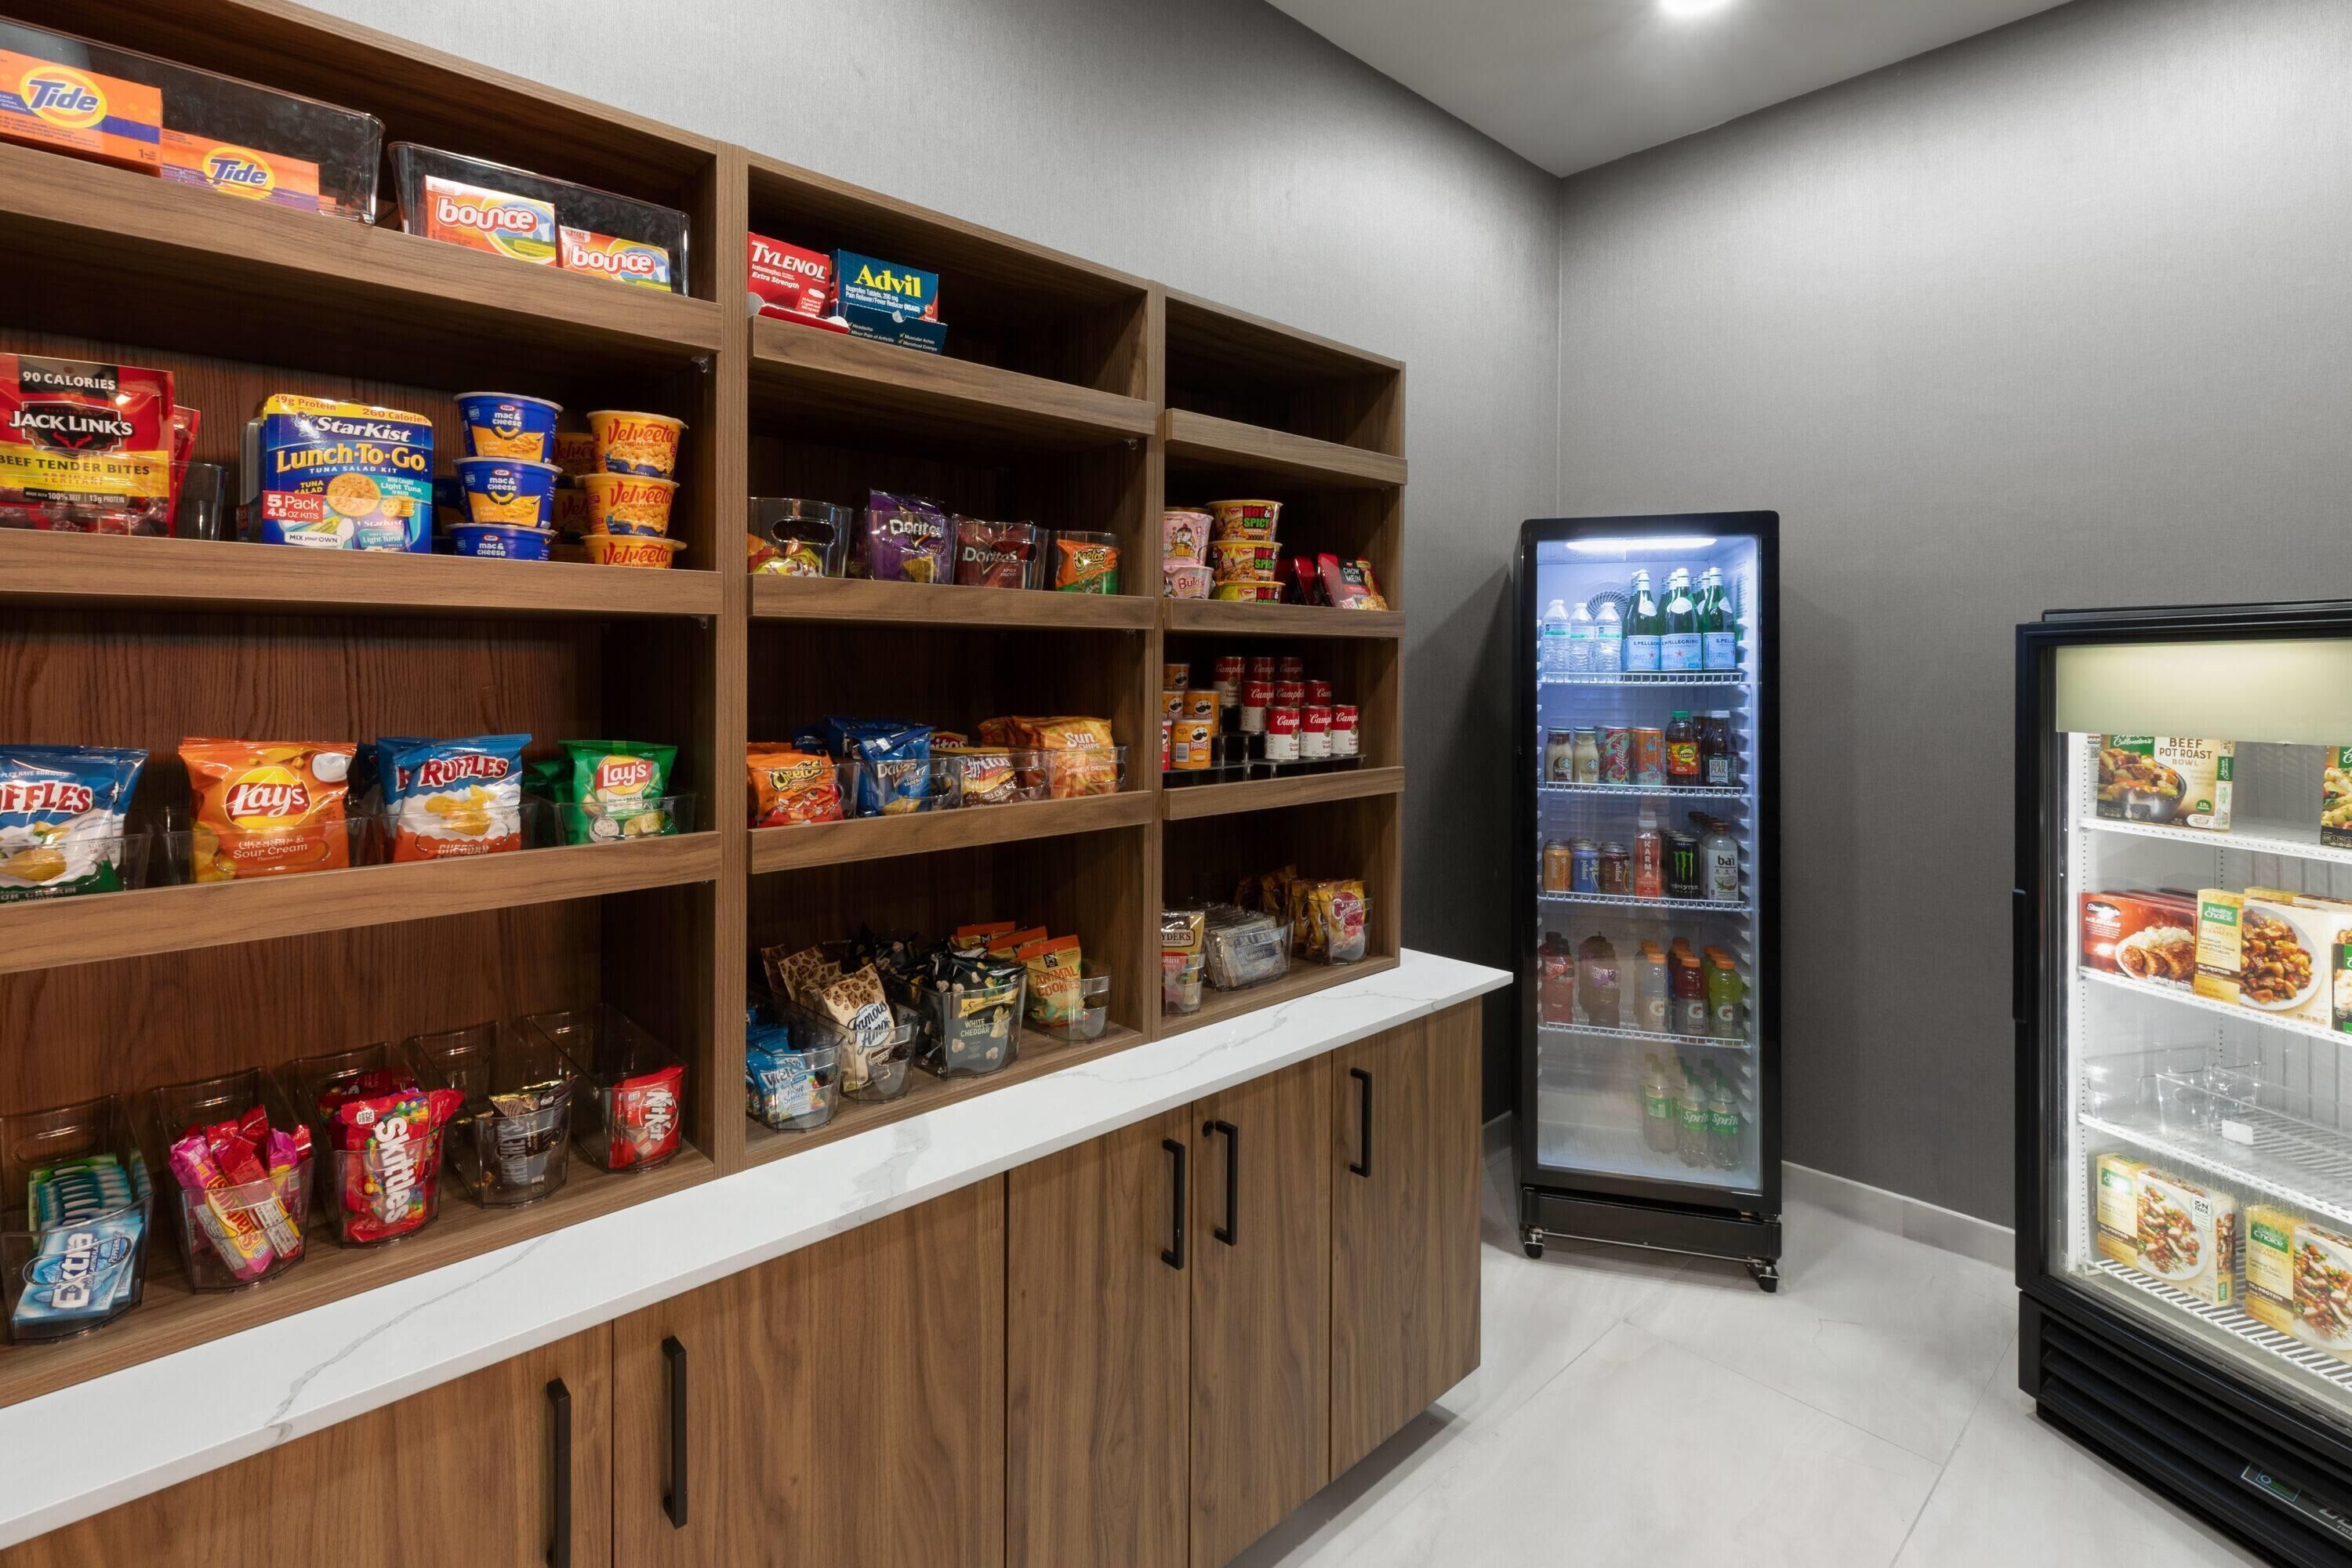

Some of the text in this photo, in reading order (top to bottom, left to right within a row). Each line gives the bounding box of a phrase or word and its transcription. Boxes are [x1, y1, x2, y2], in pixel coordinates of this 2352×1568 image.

[28, 78, 100, 112] Tide
[209, 158, 268, 185] Tide
[437, 197, 537, 232] bounce
[572, 245, 655, 273] bounce
[751, 241, 826, 279] TYLENOL
[752, 271, 770, 281] Extra
[771, 277, 800, 289] Strength
[854, 264, 921, 298] Advil
[24, 371, 116, 390] 90 CALORIES
[298, 398, 336, 411] Protein
[9, 411, 67, 431] JACK
[69, 417, 132, 436] LINK'S
[362, 408, 428, 424] 260 Calories
[315, 416, 412, 442] StarKist
[608, 419, 673, 445] Velveeta
[35, 459, 101, 473] TENDER
[107, 464, 150, 475] BITES
[48, 492, 67, 501] 100%
[89, 495, 102, 503] 13g
[404, 485, 422, 493] Tuna
[610, 481, 672, 507] Velveeta
[267, 495, 319, 510] 5 Pack
[267, 508, 286, 517] 4.5
[1244, 506, 1265, 517] HOT
[1243, 518, 1270, 528] SPICY
[602, 542, 668, 565] Velveeta
[1065, 732, 1096, 747] Sun
[2169, 738, 2203, 748] BEEF
[2159, 747, 2212, 760] POT ROAST
[420, 755, 508, 786] RUFFLES
[603, 761, 647, 787] Lay's
[771, 760, 822, 789] Cheetos
[231, 783, 305, 818] Lay's
[234, 844, 307, 858] Sour Cream
[1718, 855, 1735, 866] bai
[2205, 910, 2234, 922] Choice
[2208, 906, 2233, 916] Healthy
[1161, 931, 1191, 941] YDER'S
[1035, 966, 1079, 985] ANIMAL
[1036, 981, 1080, 996] COOKIES
[848, 1000, 887, 1030] Famous
[964, 1018, 985, 1028] WHITE
[960, 1027, 990, 1037] CHEDDAR
[375, 1117, 416, 1224] Skittles
[2253, 1229, 2284, 1247] Choice
[2258, 1287, 2283, 1301] PROTEIN
